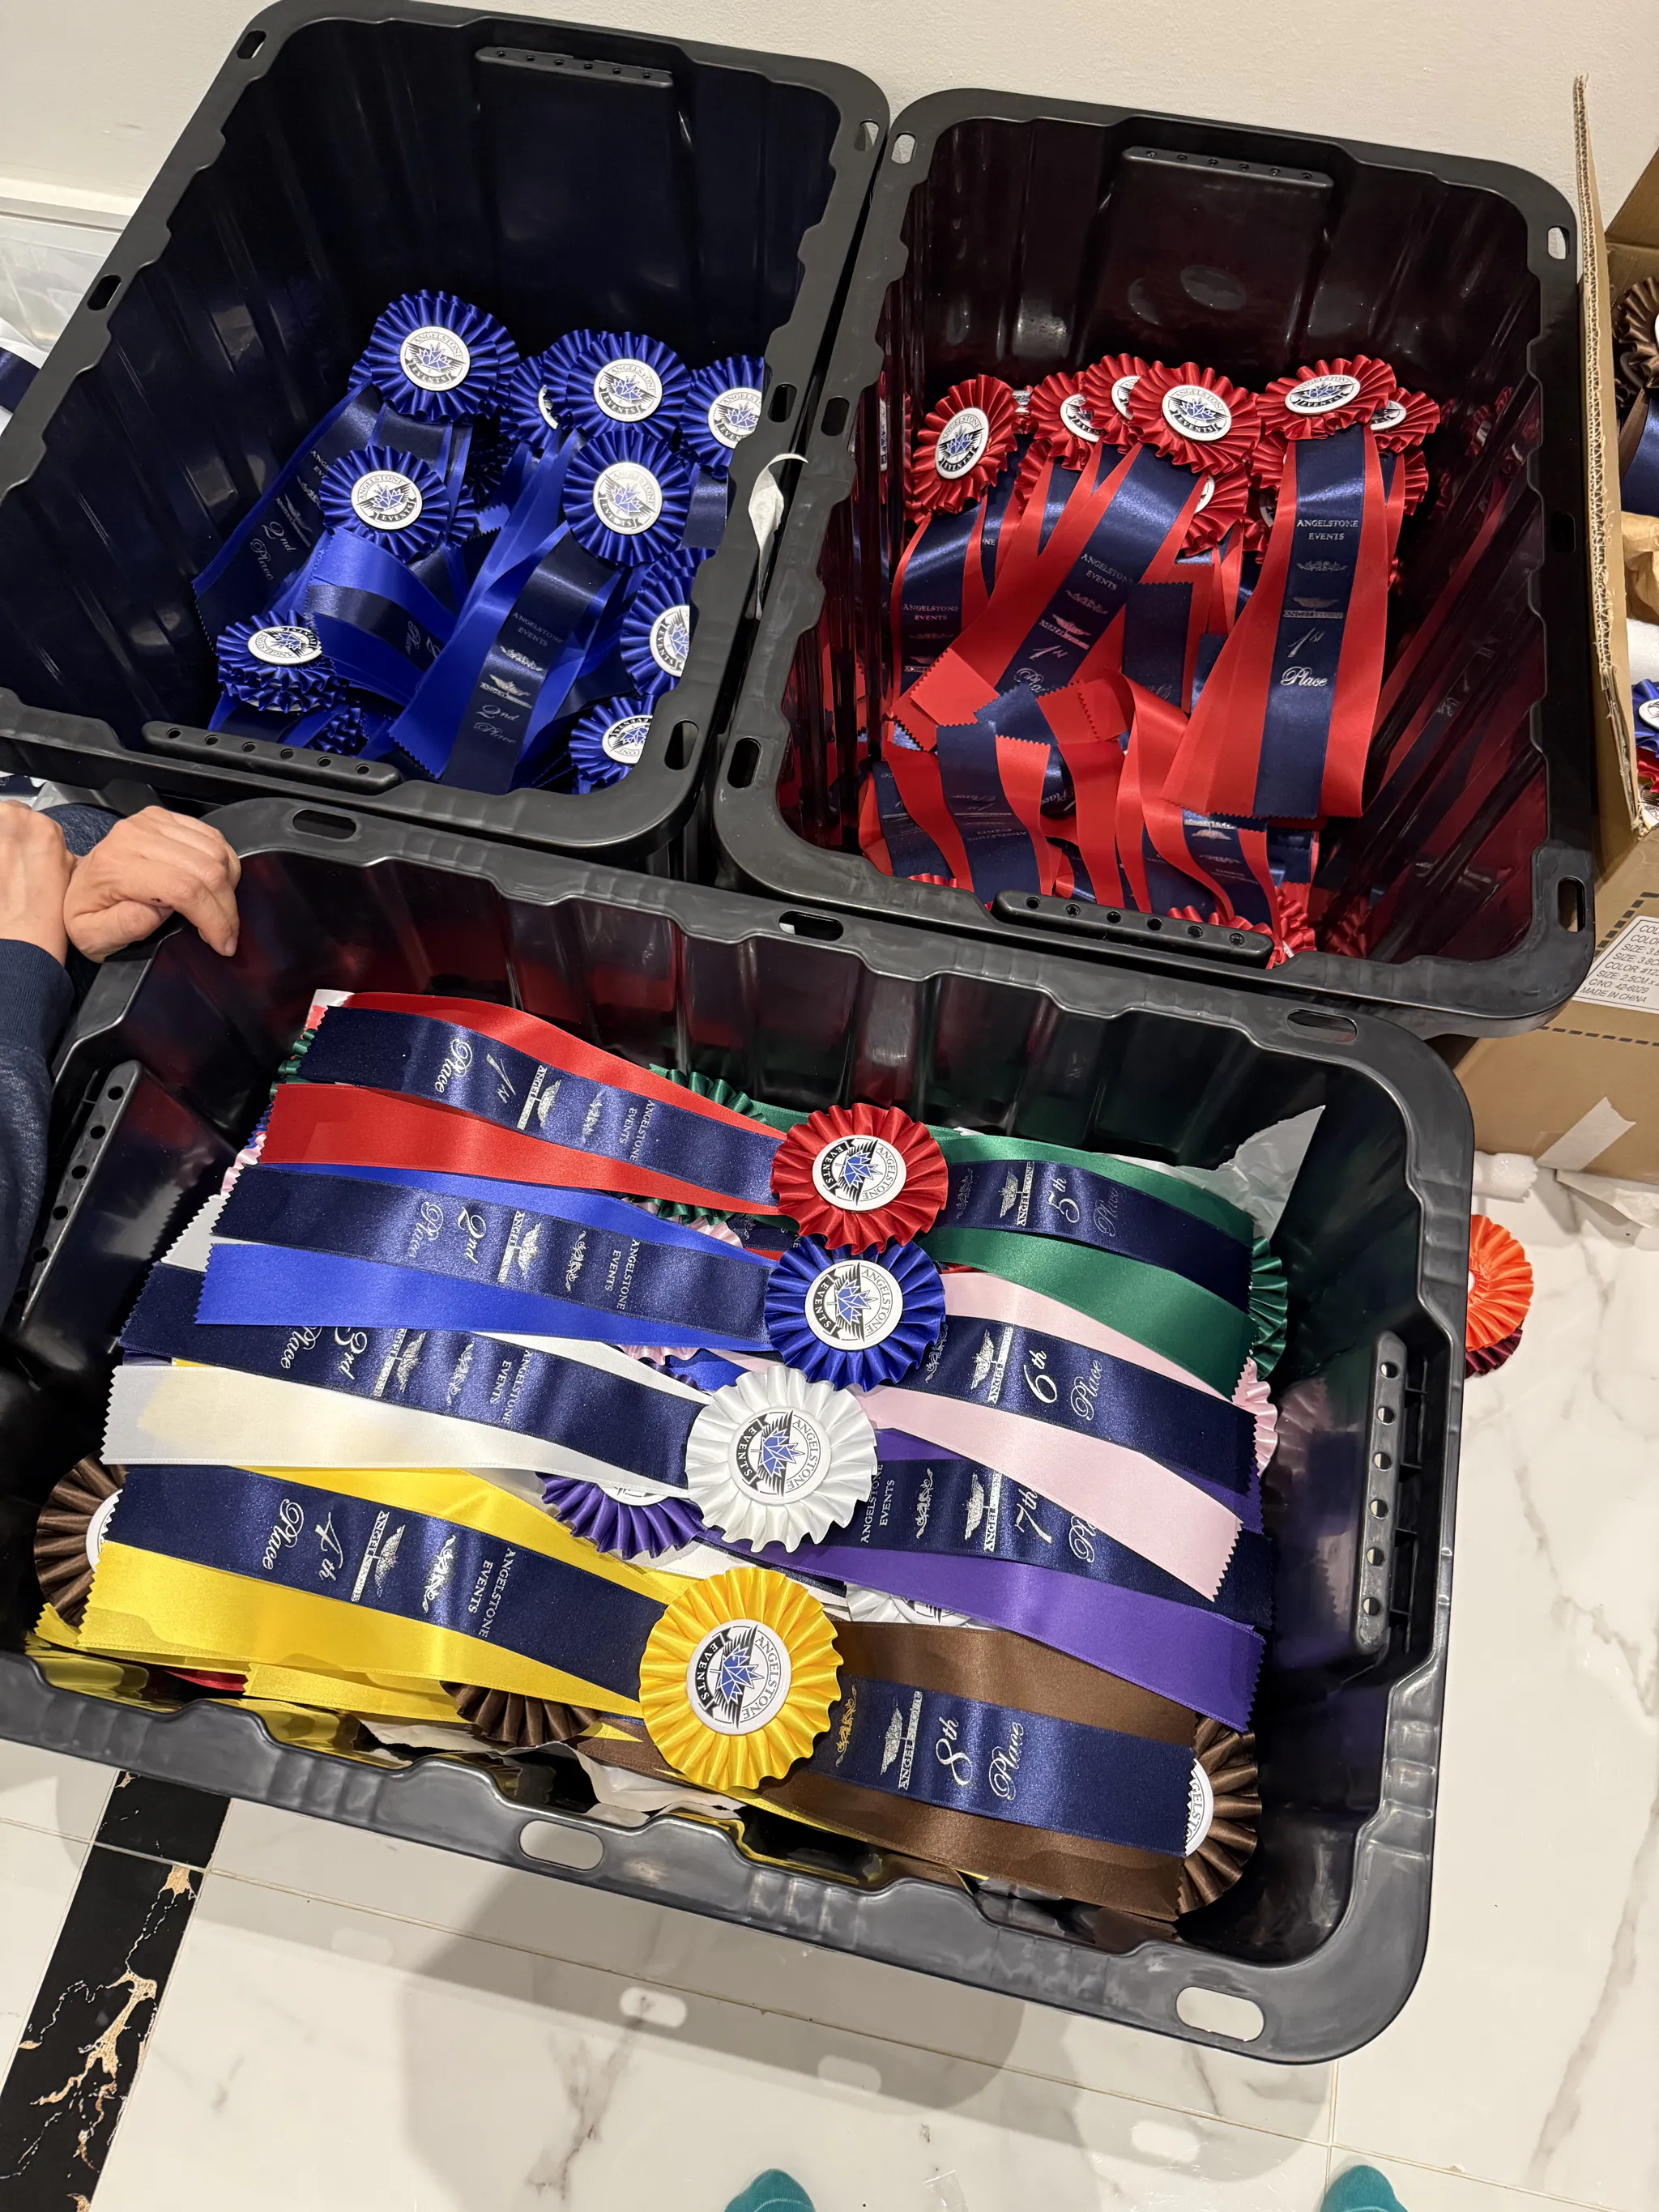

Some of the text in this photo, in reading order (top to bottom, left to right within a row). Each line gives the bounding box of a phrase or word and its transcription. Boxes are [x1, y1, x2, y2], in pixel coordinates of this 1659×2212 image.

[414, 333, 462, 357] ANGELSTONE
[412, 367, 446, 383] EVENTS
[612, 365, 655, 393] ANGELSTONE
[604, 394, 636, 414] EVENTS
[723, 392, 761, 405] ANGELST
[1176, 389, 1223, 411] ANGELSTONE
[720, 427, 744, 442] EVEN
[942, 415, 981, 441] ANGELSTONE
[1178, 415, 1213, 433] EVENTS
[944, 453, 972, 471] EVENTS
[359, 475, 403, 500] ANGELSTONE
[381, 503, 414, 522] EVENTS
[1296, 519, 1358, 527] ANGELSTONE
[262, 521, 296, 552] 2nd
[249, 539, 274, 581] Place
[1085, 569, 1118, 591] EVENTS
[512, 612, 564, 644] ANGELSTONE
[903, 603, 959, 612] ANGELSTONE
[518, 627, 548, 646] EVENTS
[657, 623, 676, 666] EVENTS
[1287, 627, 1324, 658] 1st
[1013, 667, 1047, 694] Pla
[1281, 666, 1328, 687] Place
[473, 722, 516, 744] Place
[477, 705, 520, 722] 2nd
[1621, 944, 1646, 953] SIZE:
[1640, 925, 1659, 935] COL
[1596, 970, 1620, 980] SIZE:
[1620, 974, 1649, 984] 2.5CM
[1605, 961, 1640, 973] COLOR:
[1613, 953, 1637, 962] SIZE:
[1580, 987, 1647, 1003] MADE IN CHINA
[1614, 982, 1649, 994] 42-6029
[434, 1038, 473, 1093] Place
[485, 1054, 516, 1104] 1st
[619, 1106, 638, 1144] EVENTS
[629, 1100, 655, 1161] ANGELSTONE
[823, 1145, 843, 1184] EVENTS
[862, 1146, 897, 1200] ANGELSTONE
[1047, 1177, 1080, 1223] 5th
[1093, 1187, 1120, 1237] Place
[408, 1201, 444, 1258] Place
[458, 1207, 486, 1264] 2nd
[605, 1249, 621, 1292] EVENTS
[616, 1238, 641, 1310] ANGELSTONE
[814, 1281, 831, 1328] EVENTS
[861, 1268, 891, 1334] ANGELSTONE
[280, 1326, 322, 1370] Place
[334, 1326, 368, 1380] 3rd
[373, 1328, 408, 1397] NGELSTONE
[489, 1360, 513, 1404] EVENTS
[501, 1349, 532, 1424] ANGELSTONE
[1023, 1349, 1058, 1404] 6th
[1070, 1359, 1102, 1421] Place
[738, 1427, 757, 1477] EVENTS
[786, 1418, 819, 1490] ANGELSTONE
[860, 1464, 884, 1543] ANGELSTONE
[878, 1479, 895, 1527] EVENTS
[1014, 1488, 1052, 1545] 7th
[262, 1498, 305, 1570] Place
[314, 1511, 344, 1582] 4th
[467, 1560, 493, 1613] EVENTS
[478, 1547, 516, 1638] ANGELSTONE
[697, 1642, 719, 1701] EVENTS
[741, 1635, 779, 1720] ANGELSTONE
[936, 1716, 973, 1787] 8th
[988, 1722, 1024, 1801] Place
[1186, 1782, 1203, 1839] GELSTO
